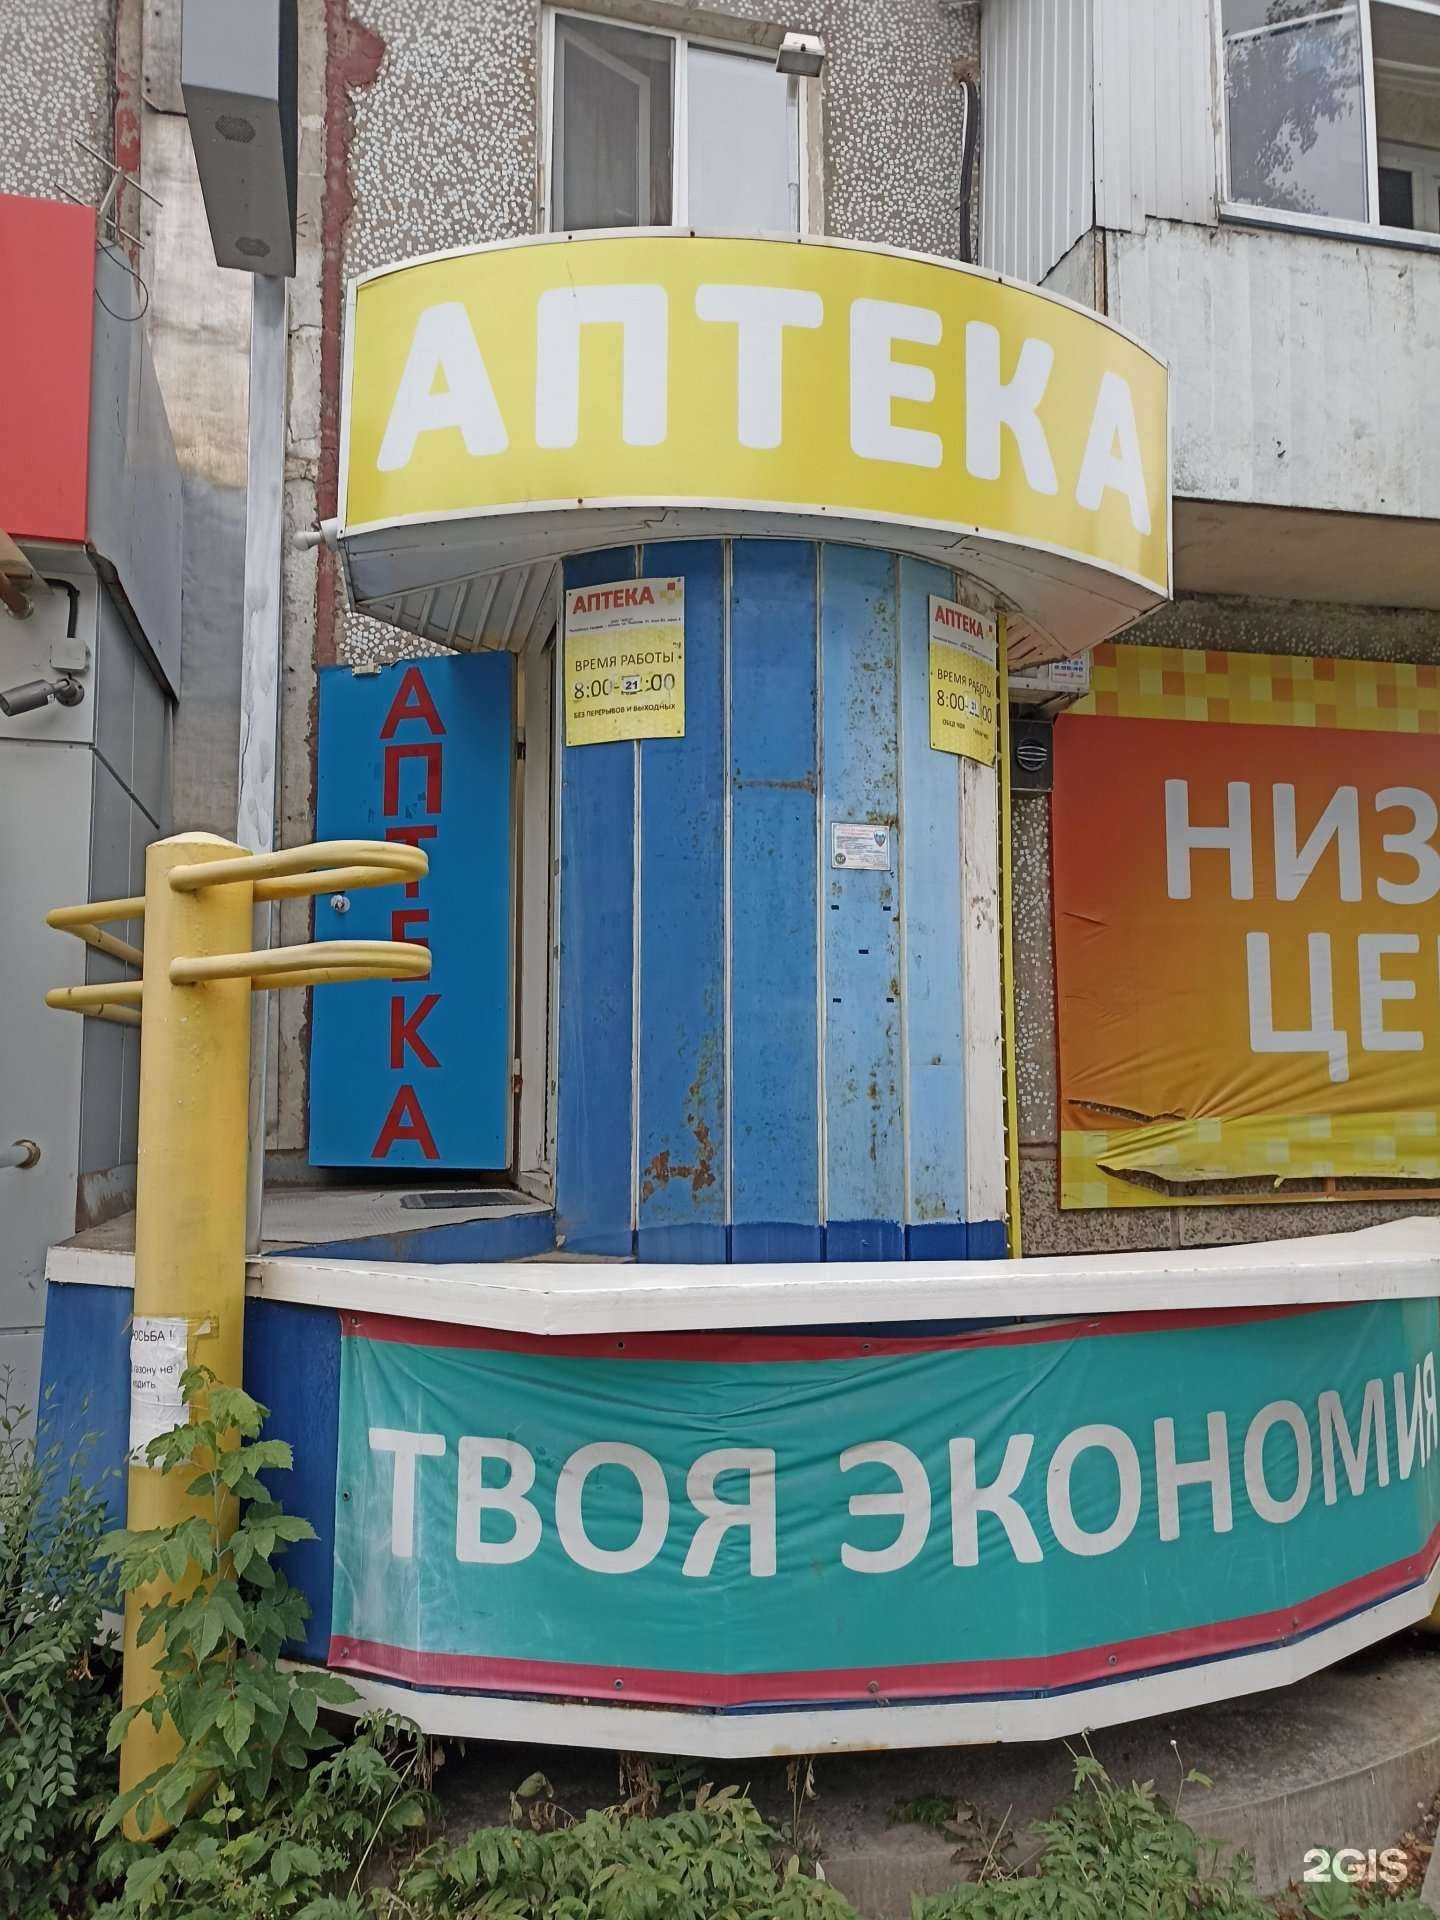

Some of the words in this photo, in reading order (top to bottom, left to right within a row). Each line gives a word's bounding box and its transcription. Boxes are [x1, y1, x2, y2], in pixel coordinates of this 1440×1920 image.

[376, 283, 1152, 535] АПТЕКА
[572, 586, 655, 615] АПТЕКА
[935, 605, 984, 640] АПТЕКА
[575, 656, 617, 672] ВРЕМЯ
[620, 651, 674, 666] РАБОТЫ
[937, 668, 967, 686] ВРЕМЯ
[1164, 778, 1440, 905] НИЗ
[1246, 932, 1440, 1083] ЦЕ
[133, 1329, 166, 1342] ОСЬБА
[160, 1365, 173, 1374] не
[368, 1428, 777, 1577] ТВОЯ
[839, 1351, 1438, 1574] ЭКОНОМИЯ
